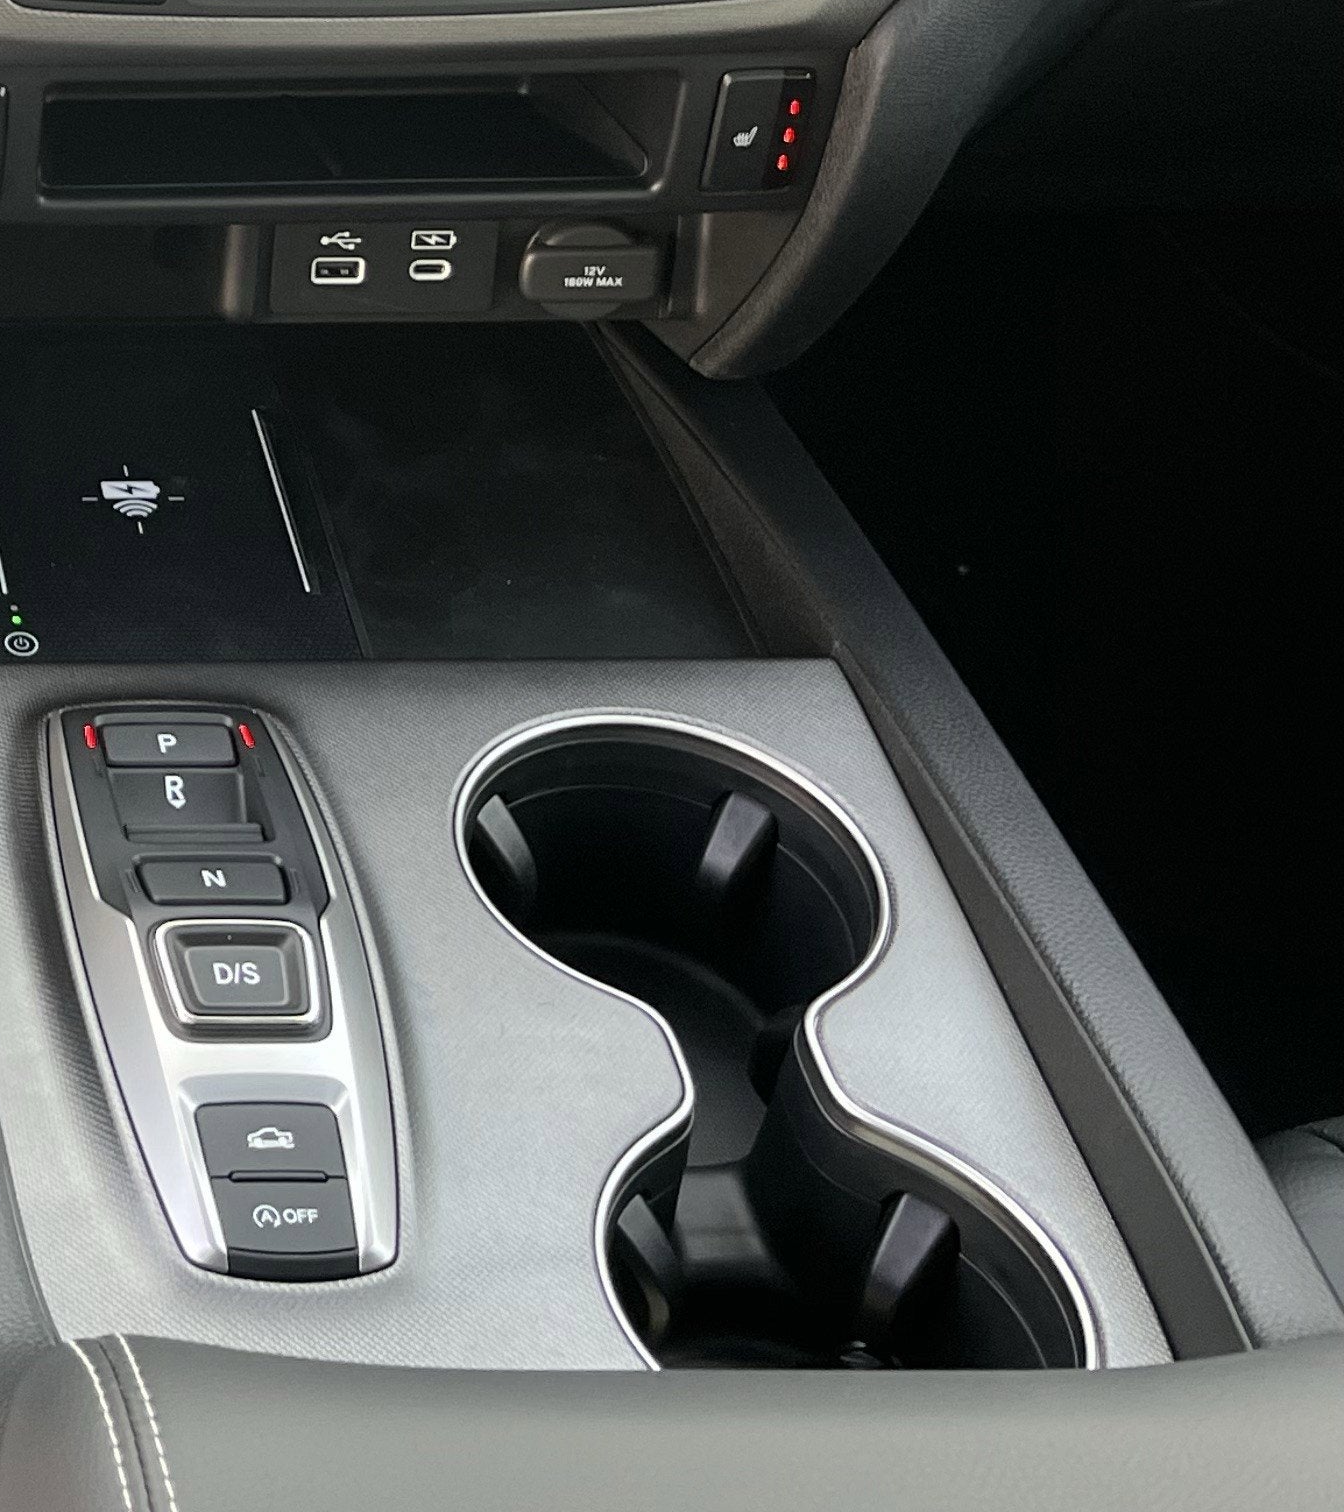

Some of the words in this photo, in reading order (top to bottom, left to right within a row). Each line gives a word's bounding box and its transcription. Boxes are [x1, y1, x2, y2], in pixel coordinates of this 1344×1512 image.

[584, 266, 606, 276] 12V
[596, 277, 623, 287] MAX
[157, 733, 177, 753] P
[164, 775, 185, 803] R
[201, 869, 227, 888] N
[212, 962, 261, 986] D/S
[282, 1208, 319, 1225] OFF
